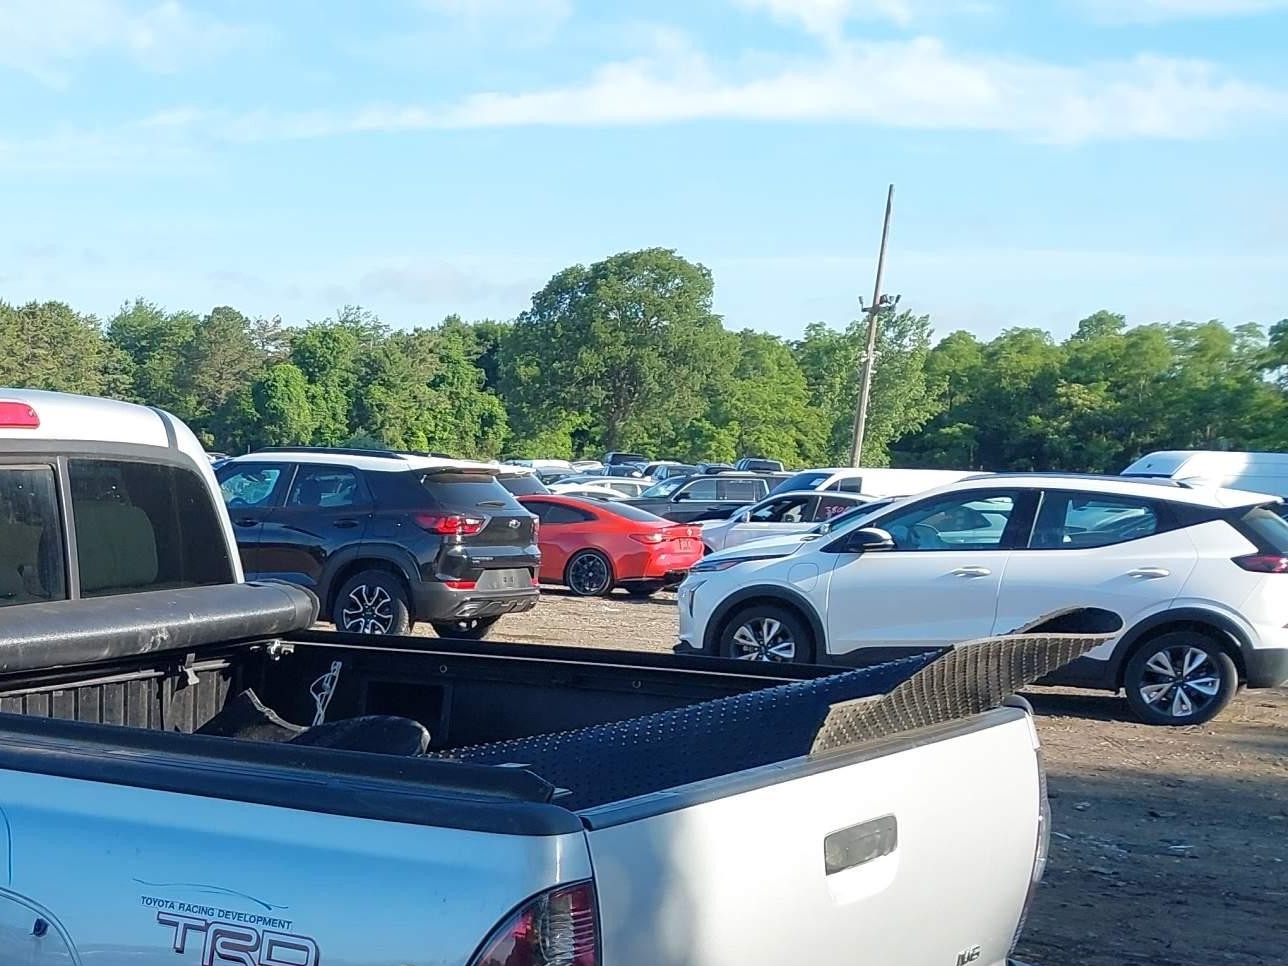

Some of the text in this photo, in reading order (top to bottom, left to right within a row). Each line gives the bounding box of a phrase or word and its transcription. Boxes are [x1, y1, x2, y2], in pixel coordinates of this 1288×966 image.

[141, 896, 292, 930] TOYOTA RACING DEVELOPMENT
